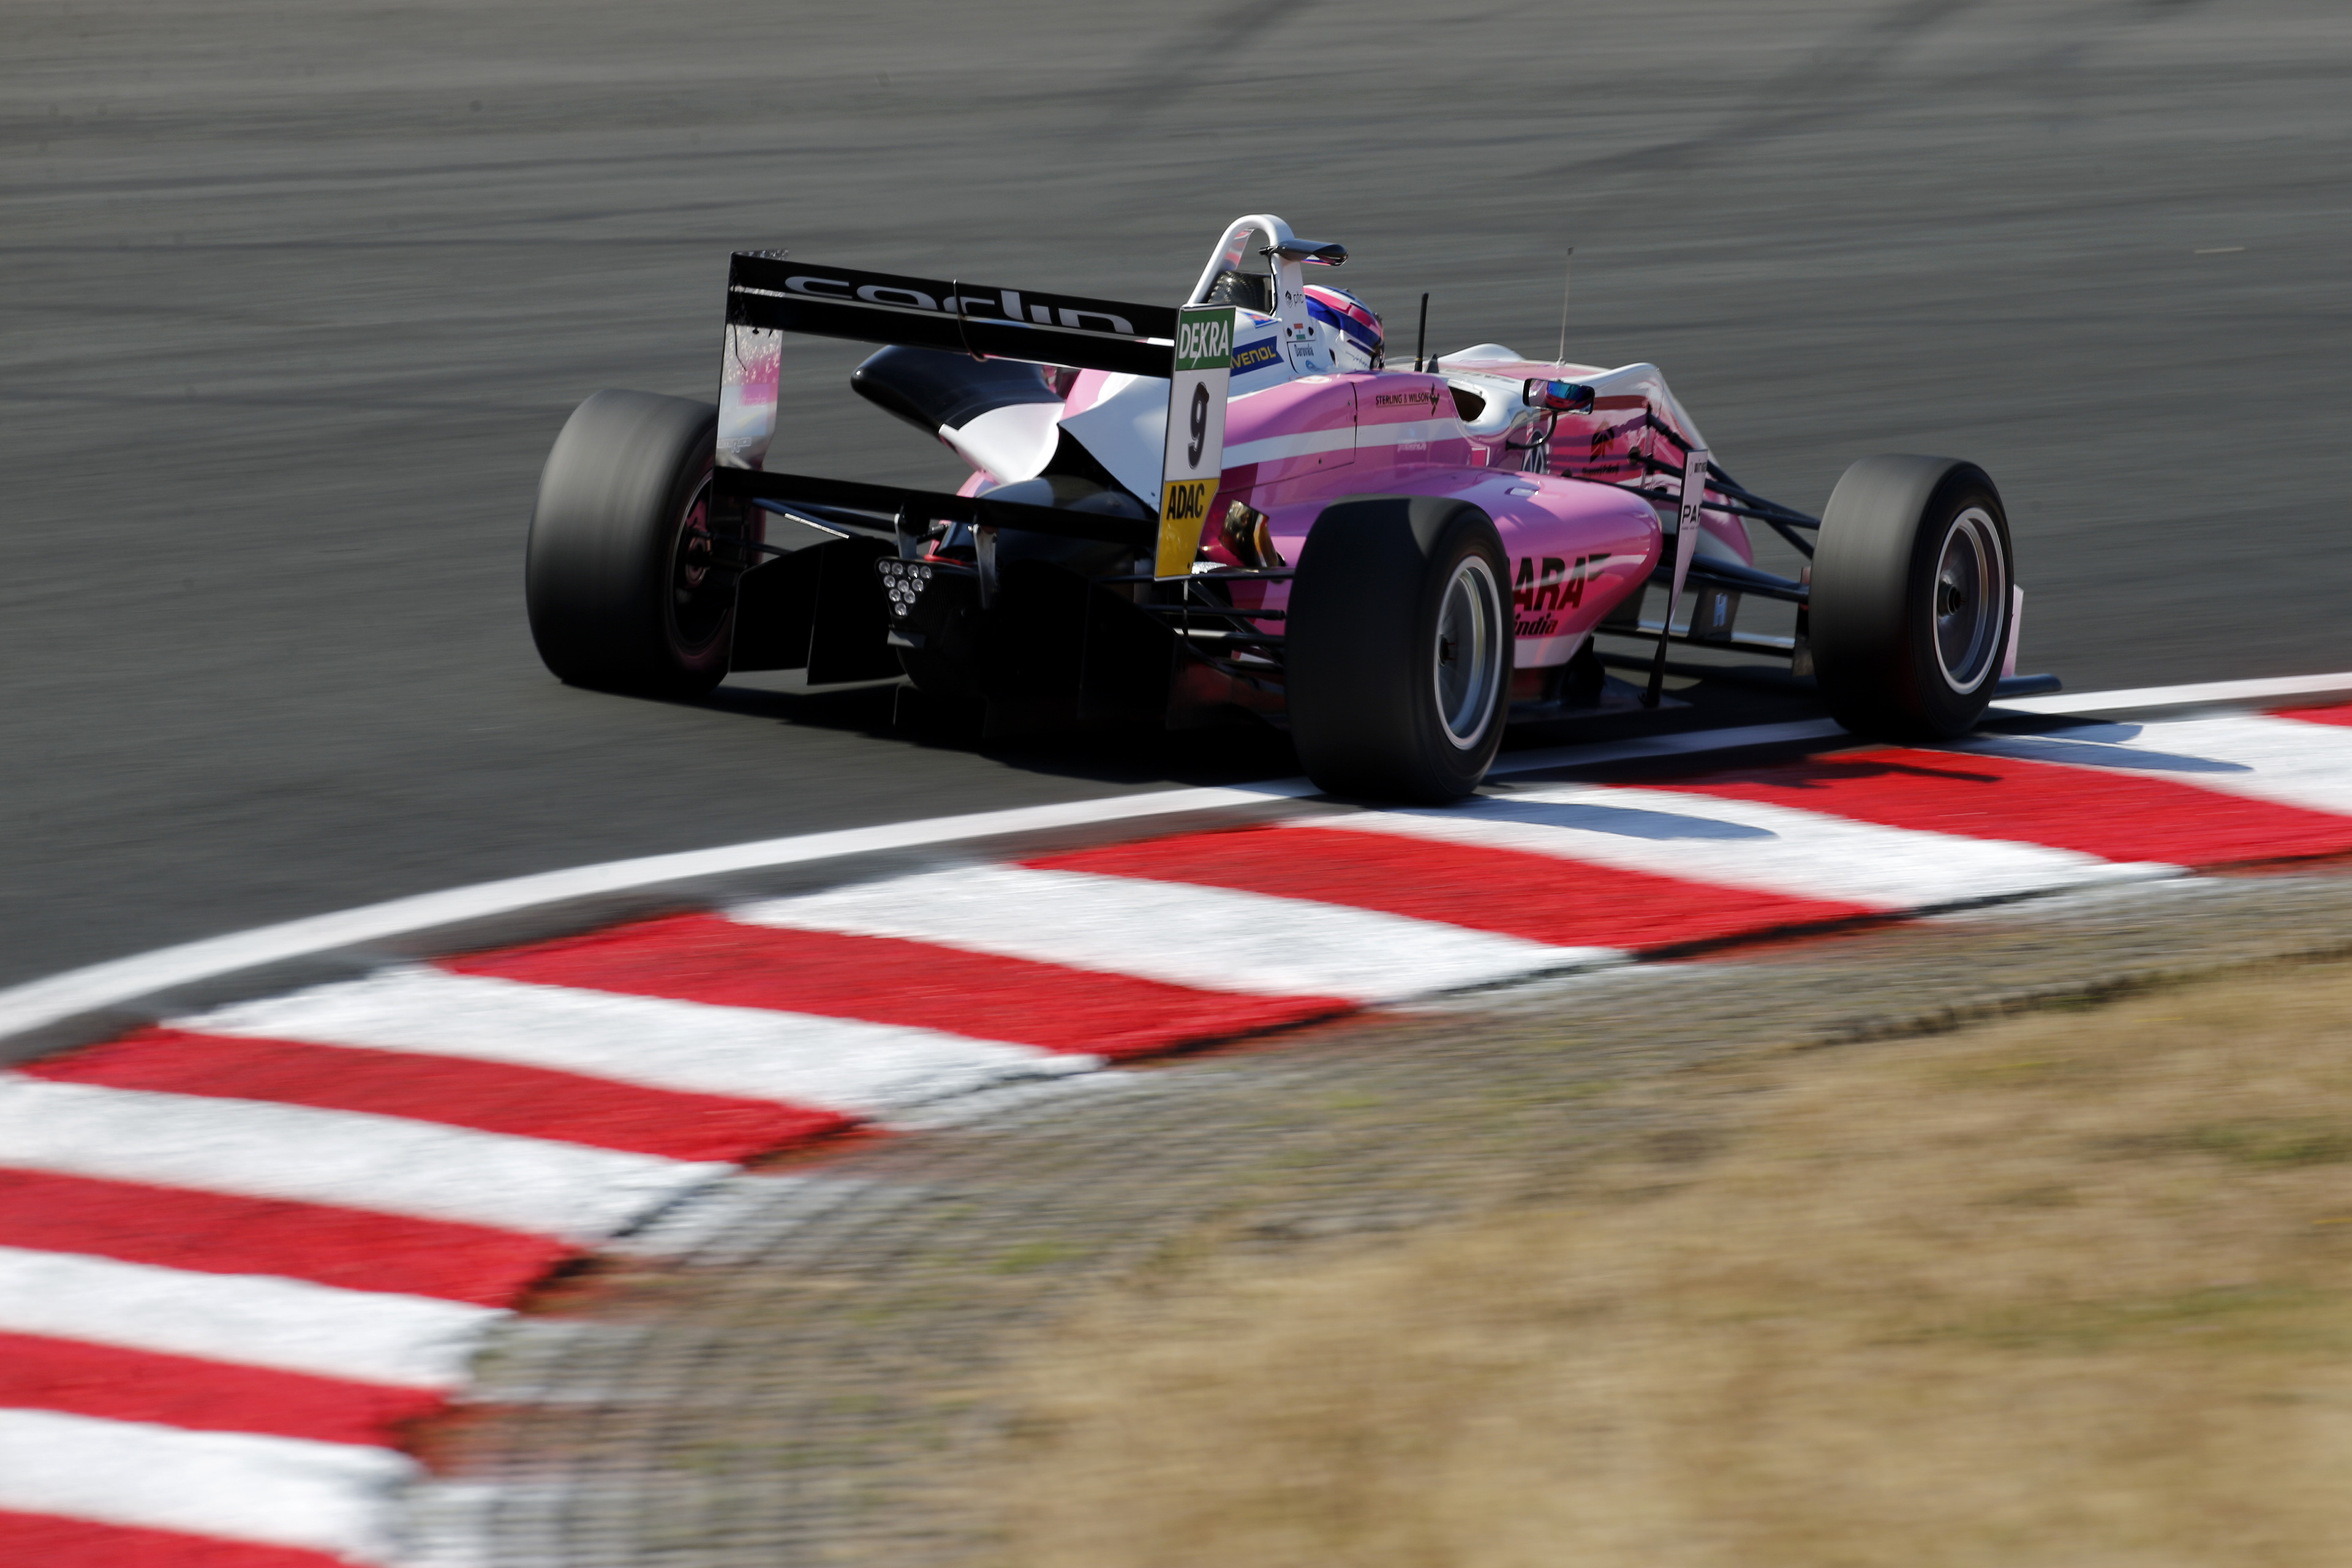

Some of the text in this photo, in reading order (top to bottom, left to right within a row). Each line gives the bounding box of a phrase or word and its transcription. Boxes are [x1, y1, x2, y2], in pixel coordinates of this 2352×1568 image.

[785, 276, 1134, 334] carlin
[1178, 319, 1229, 360] DEKRA
[1376, 393, 1429, 405] STERLING & WILSON
[1188, 381, 1210, 470] 9
[1166, 483, 1205, 521] ADAC
